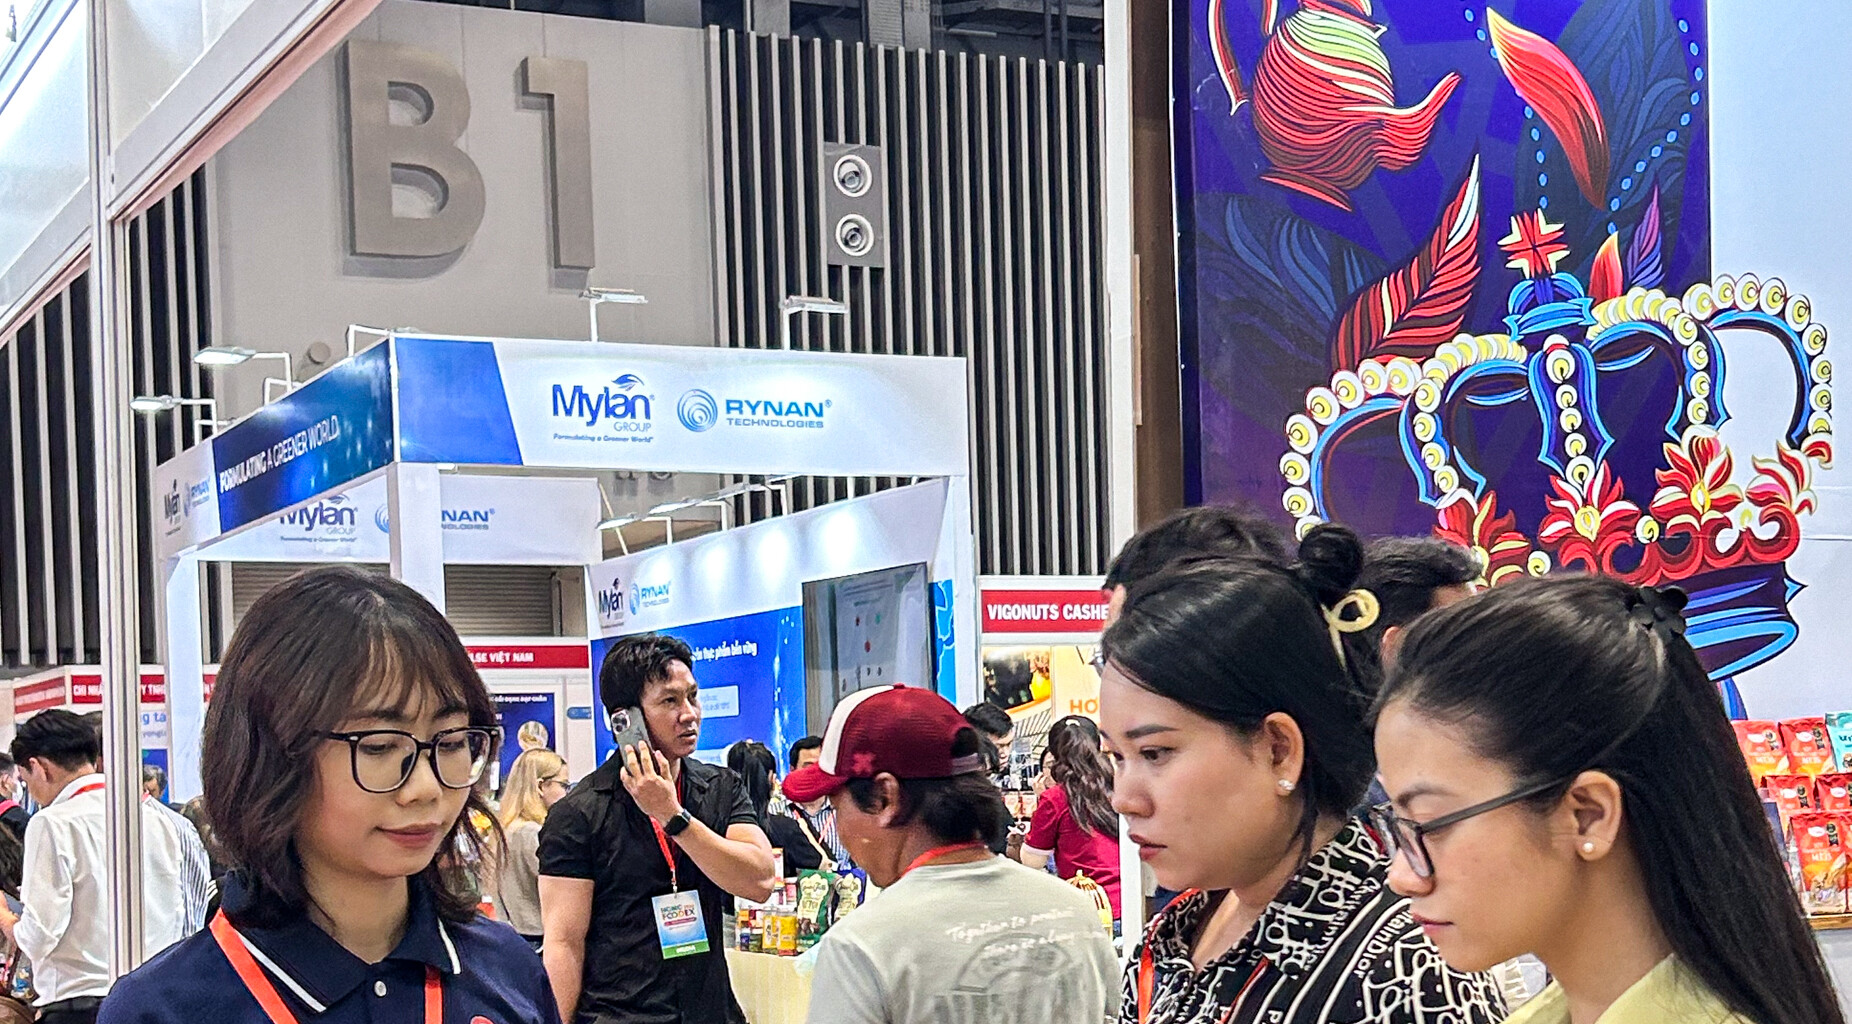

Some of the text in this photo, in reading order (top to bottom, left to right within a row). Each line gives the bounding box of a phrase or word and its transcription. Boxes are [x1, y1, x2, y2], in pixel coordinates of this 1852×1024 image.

[346, 38, 596, 270] B1
[552, 384, 652, 427] Mylan
[725, 399, 824, 418] RYNAN
[613, 421, 652, 432] GROUP
[726, 417, 824, 429] TECHNOLOGIES
[219, 451, 268, 494] FORMULATING
[273, 429, 308, 467] GREENER
[441, 509, 489, 522] NAN
[986, 603, 1110, 621] VIGONUTS CASHE
[489, 650, 511, 665] VIỆT
[513, 652, 535, 663] NAM
